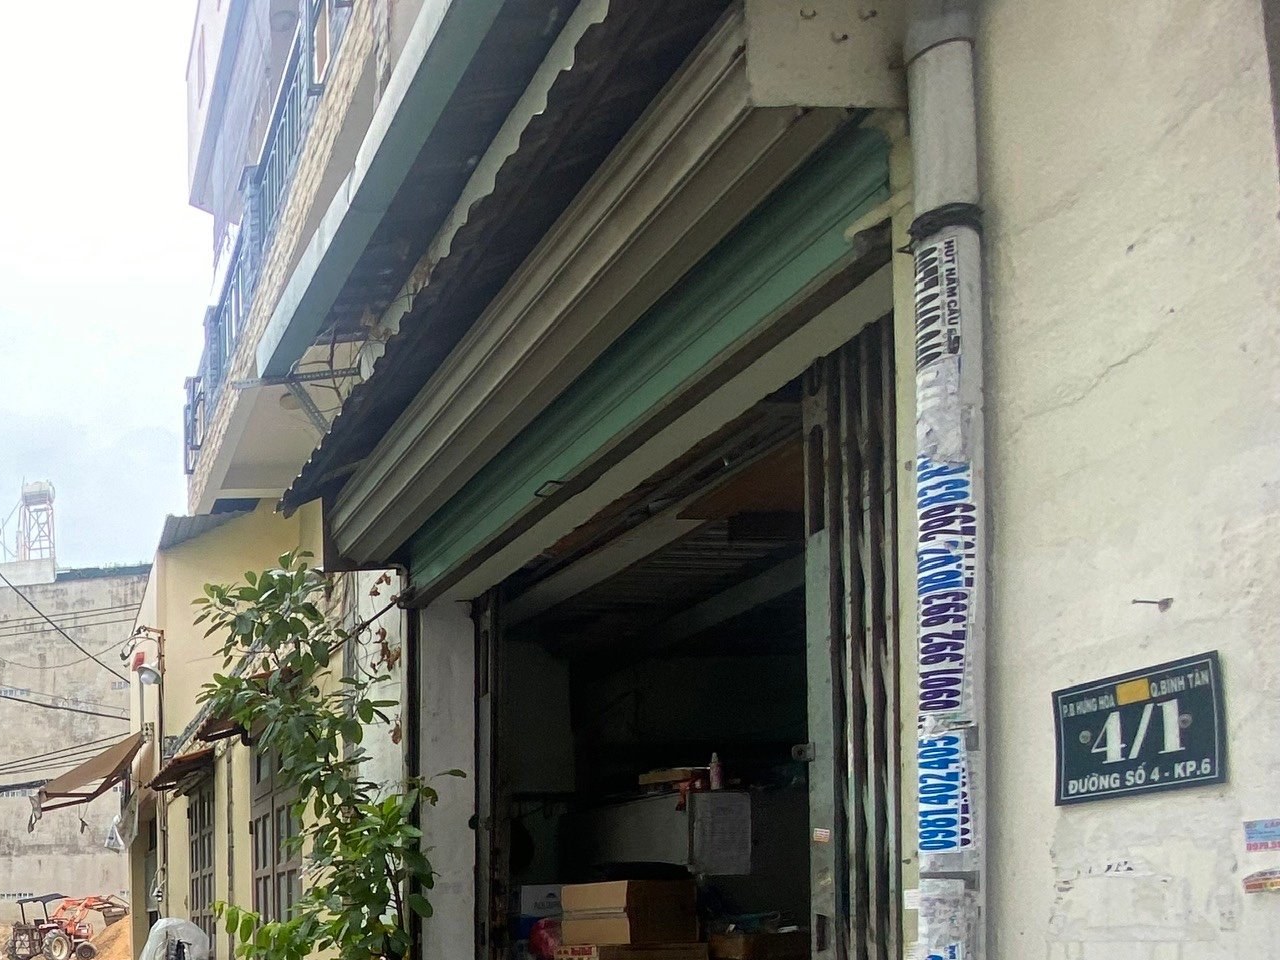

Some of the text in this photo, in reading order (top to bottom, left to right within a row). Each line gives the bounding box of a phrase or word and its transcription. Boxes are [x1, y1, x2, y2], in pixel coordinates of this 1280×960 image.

[918, 591, 969, 711] 0901.992.993
[1187, 668, 1210, 689] TÂN
[1091, 698, 1186, 765] 4/1
[1068, 772, 1120, 795] ĐƯỜNG
[1124, 762, 1147, 785] SỐ
[1150, 766, 1160, 783] 4
[1174, 758, 1211, 779] KP.6
